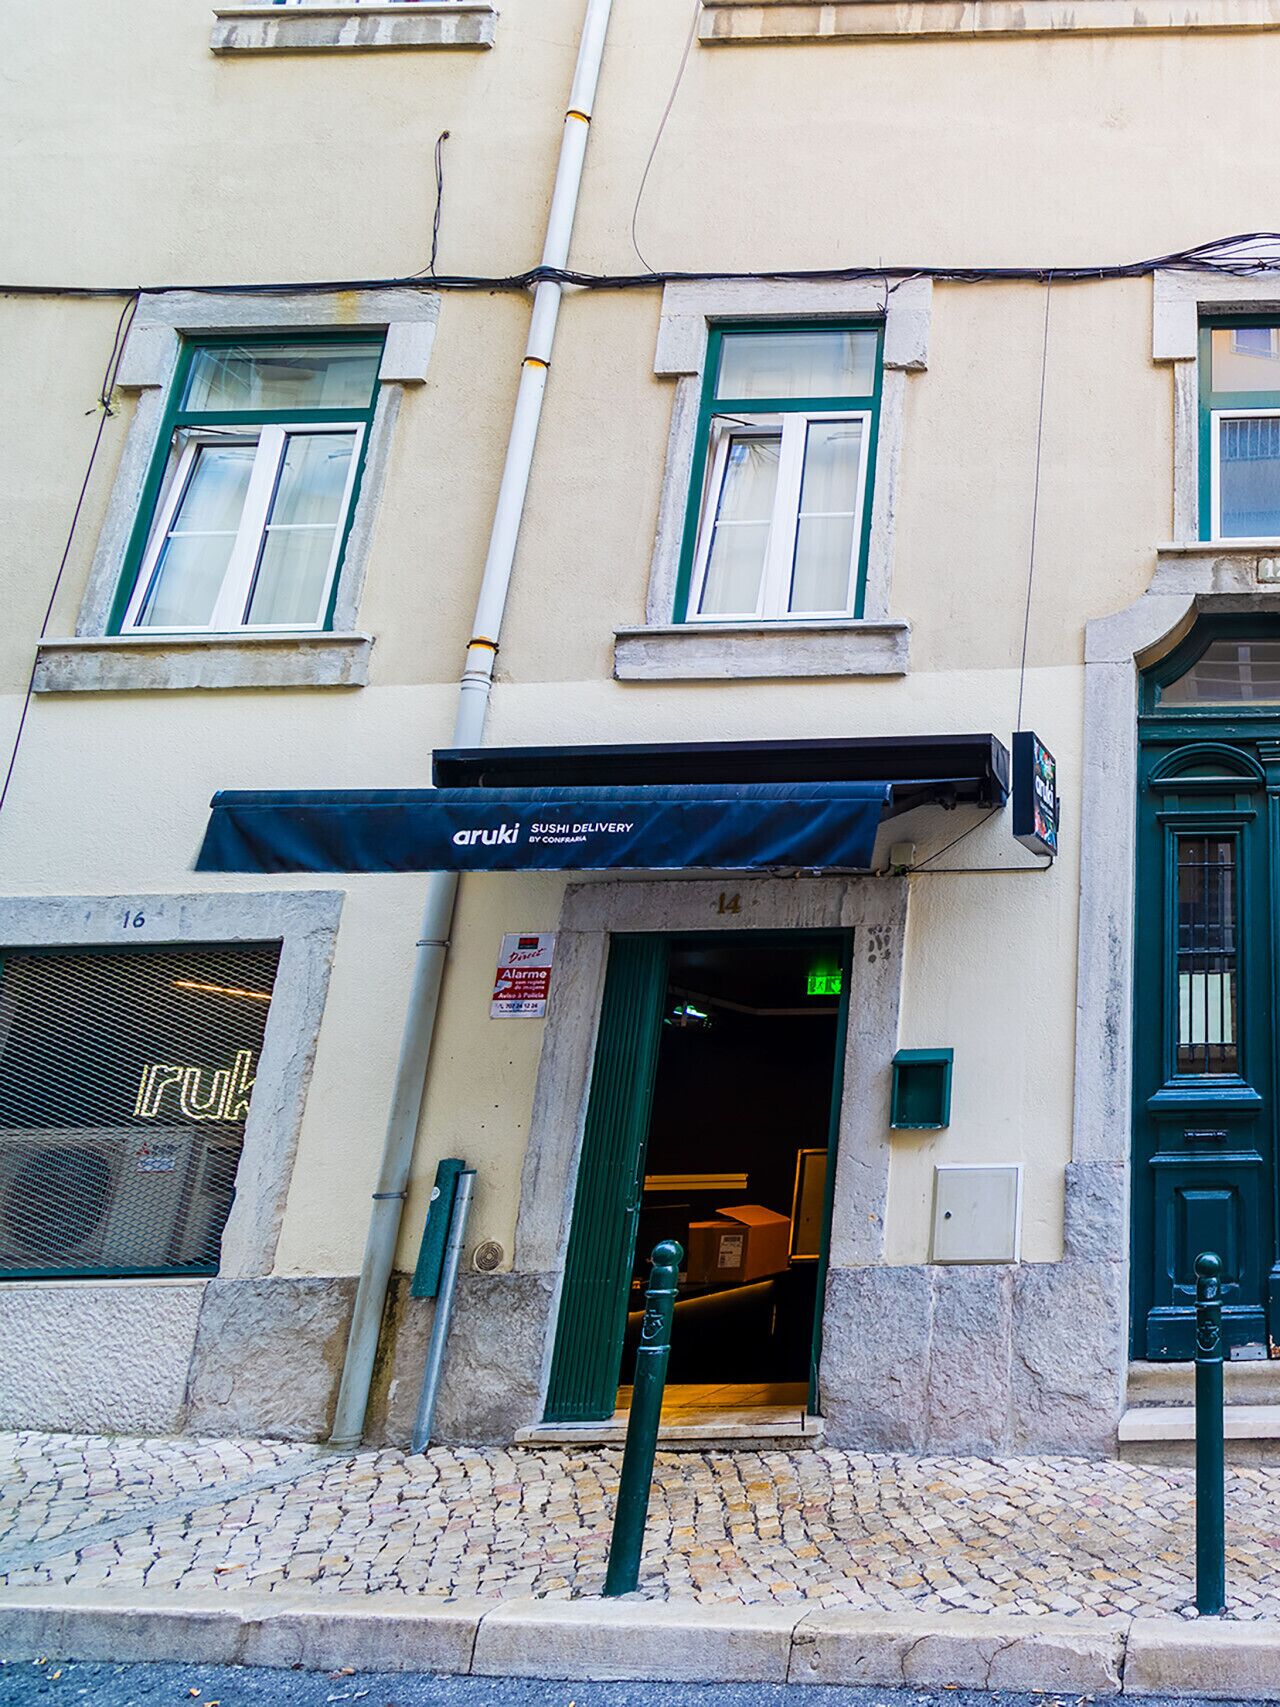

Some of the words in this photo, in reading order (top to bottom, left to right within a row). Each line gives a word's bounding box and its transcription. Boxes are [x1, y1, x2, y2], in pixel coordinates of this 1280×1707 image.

[453, 823, 520, 846] aruki
[530, 823, 569, 833] SUSHI
[572, 822, 634, 833] DELIVERY
[542, 835, 587, 844] CONFRARIA
[717, 892, 741, 914] 14
[123, 910, 145, 929] 16
[501, 969, 547, 979] Alarme
